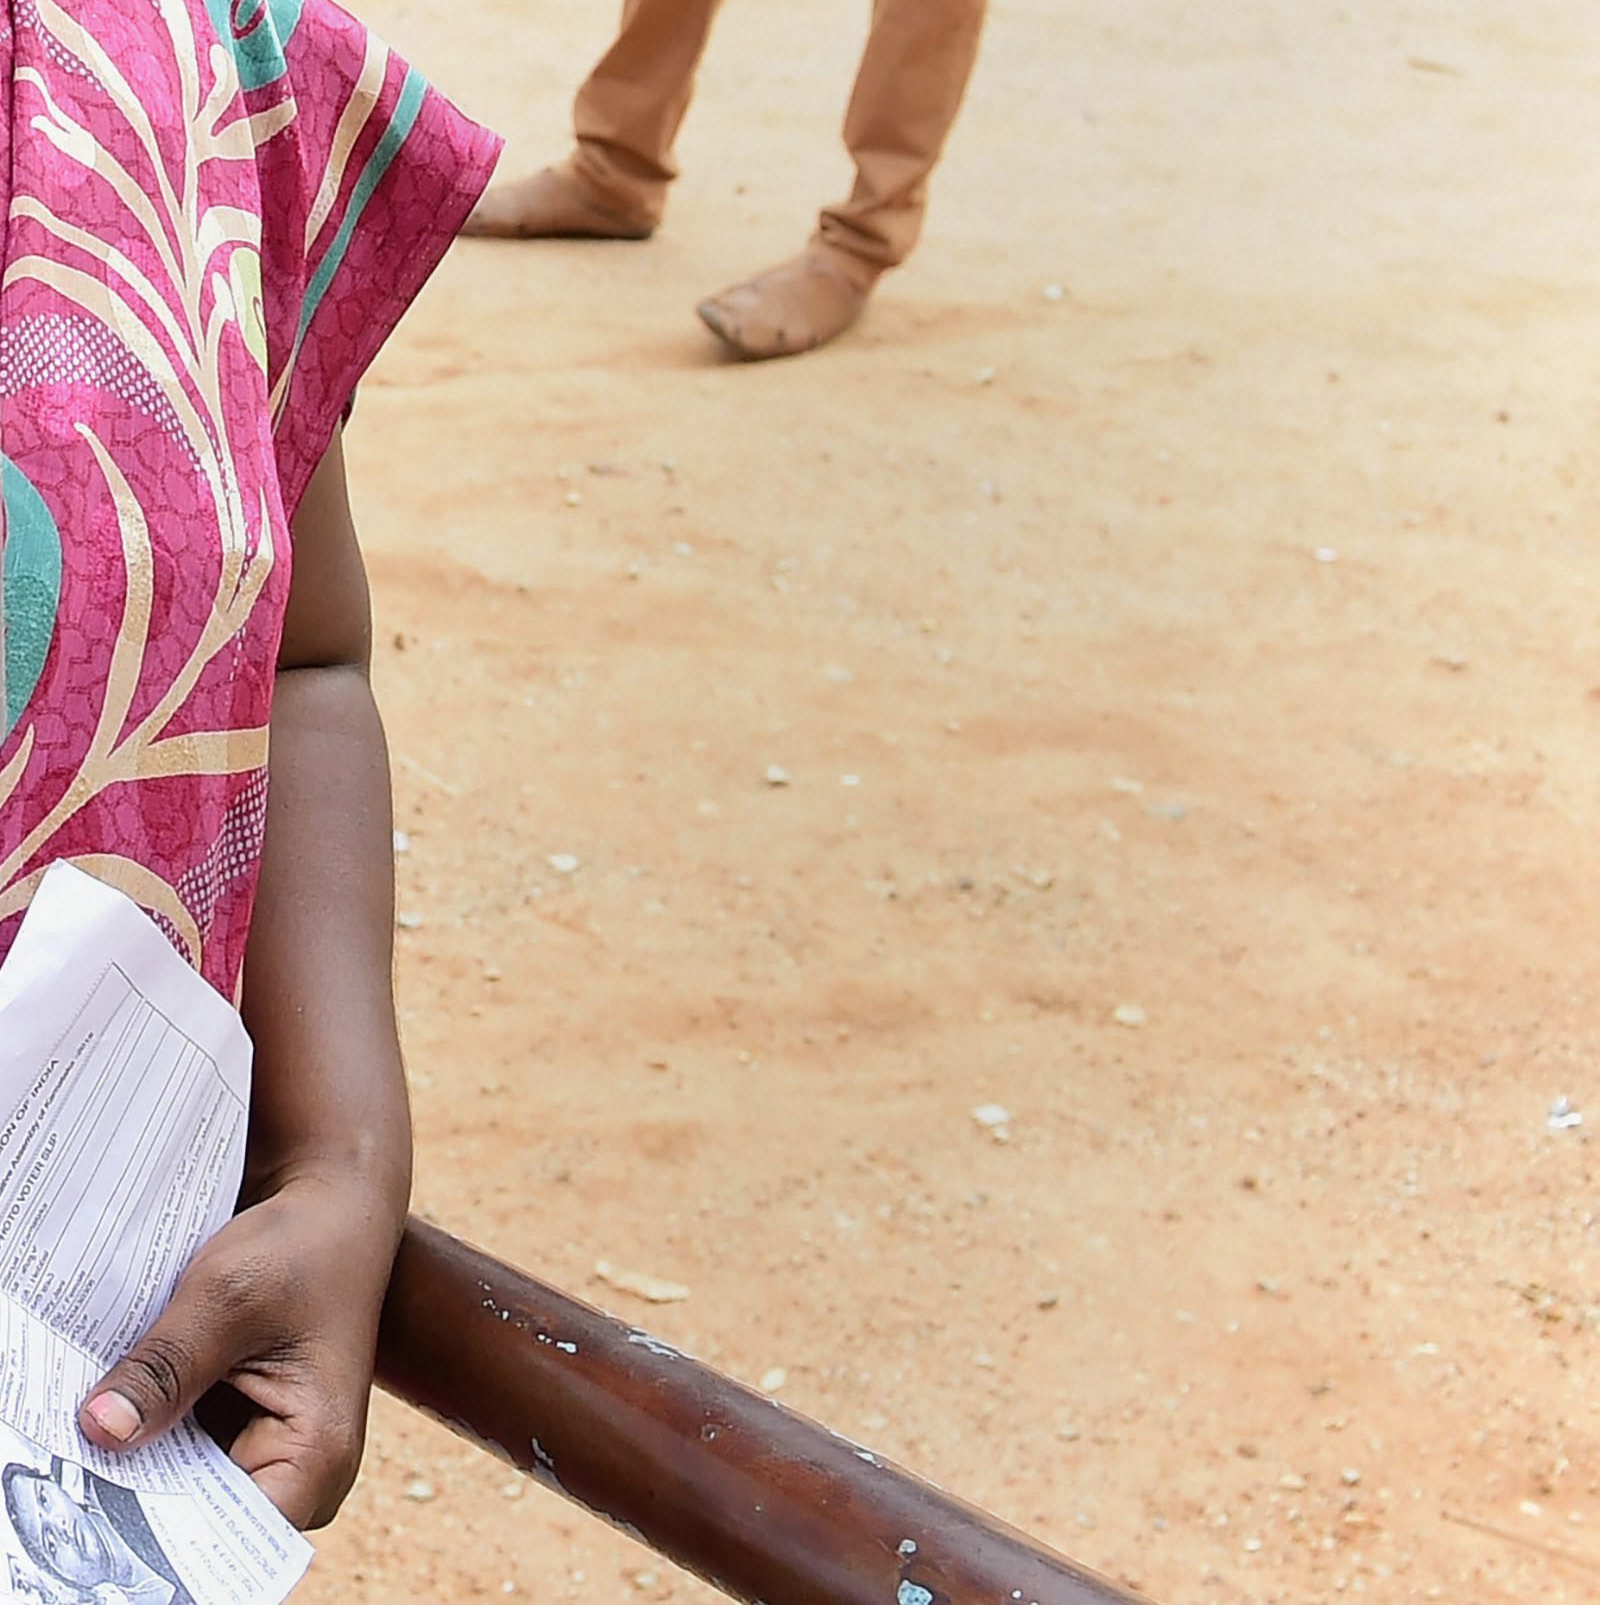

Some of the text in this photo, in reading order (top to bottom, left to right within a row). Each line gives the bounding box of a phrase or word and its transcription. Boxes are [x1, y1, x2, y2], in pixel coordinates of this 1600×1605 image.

[16, 1098, 32, 1121] OF
[31, 1059, 59, 1097] INDIA
[17, 1162, 44, 1202] VOTER
[41, 1132, 58, 1161] SLIP
